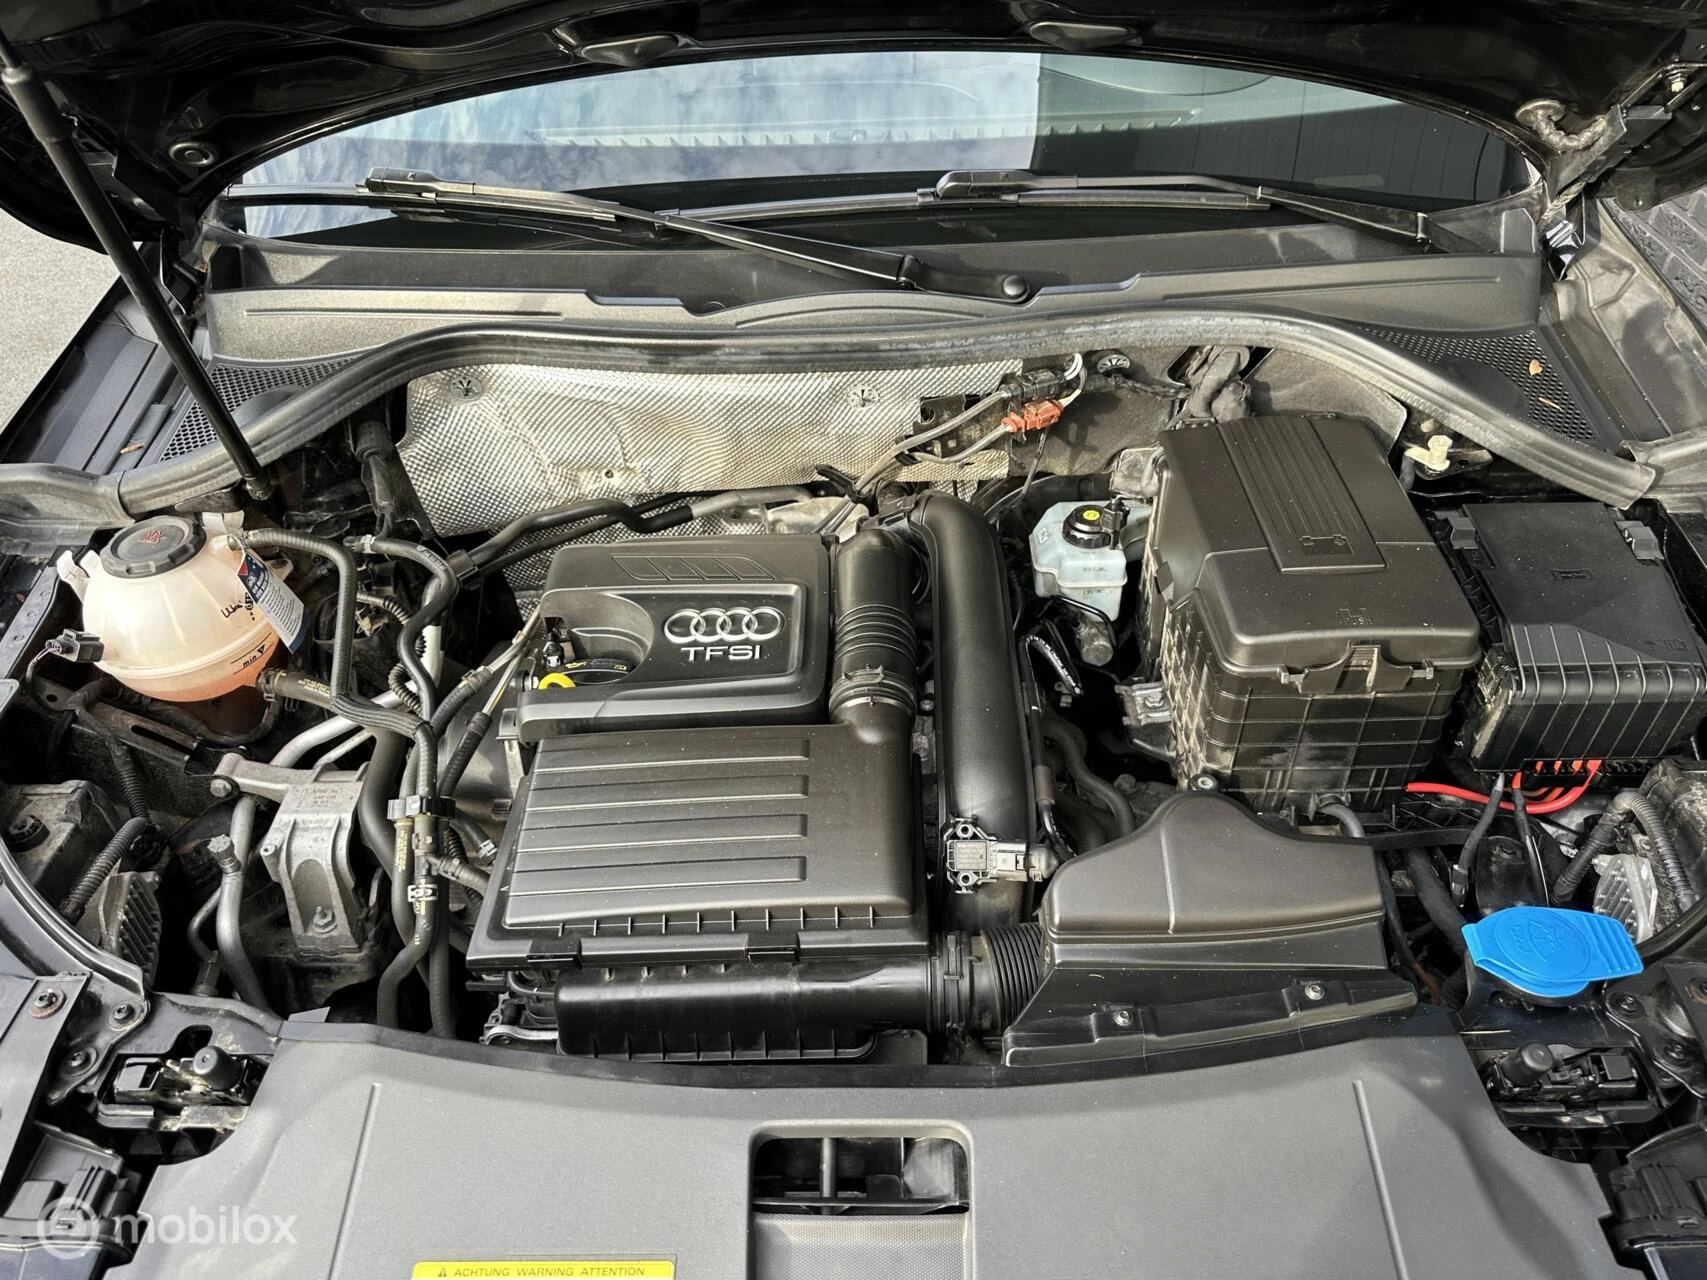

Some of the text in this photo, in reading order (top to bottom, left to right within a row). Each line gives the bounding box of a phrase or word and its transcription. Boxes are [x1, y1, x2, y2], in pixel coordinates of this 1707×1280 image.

[681, 644, 761, 662] TFSI
[242, 655, 258, 668] min
[453, 1267, 646, 1278] ACHTUNG WARNING ATTENTION
